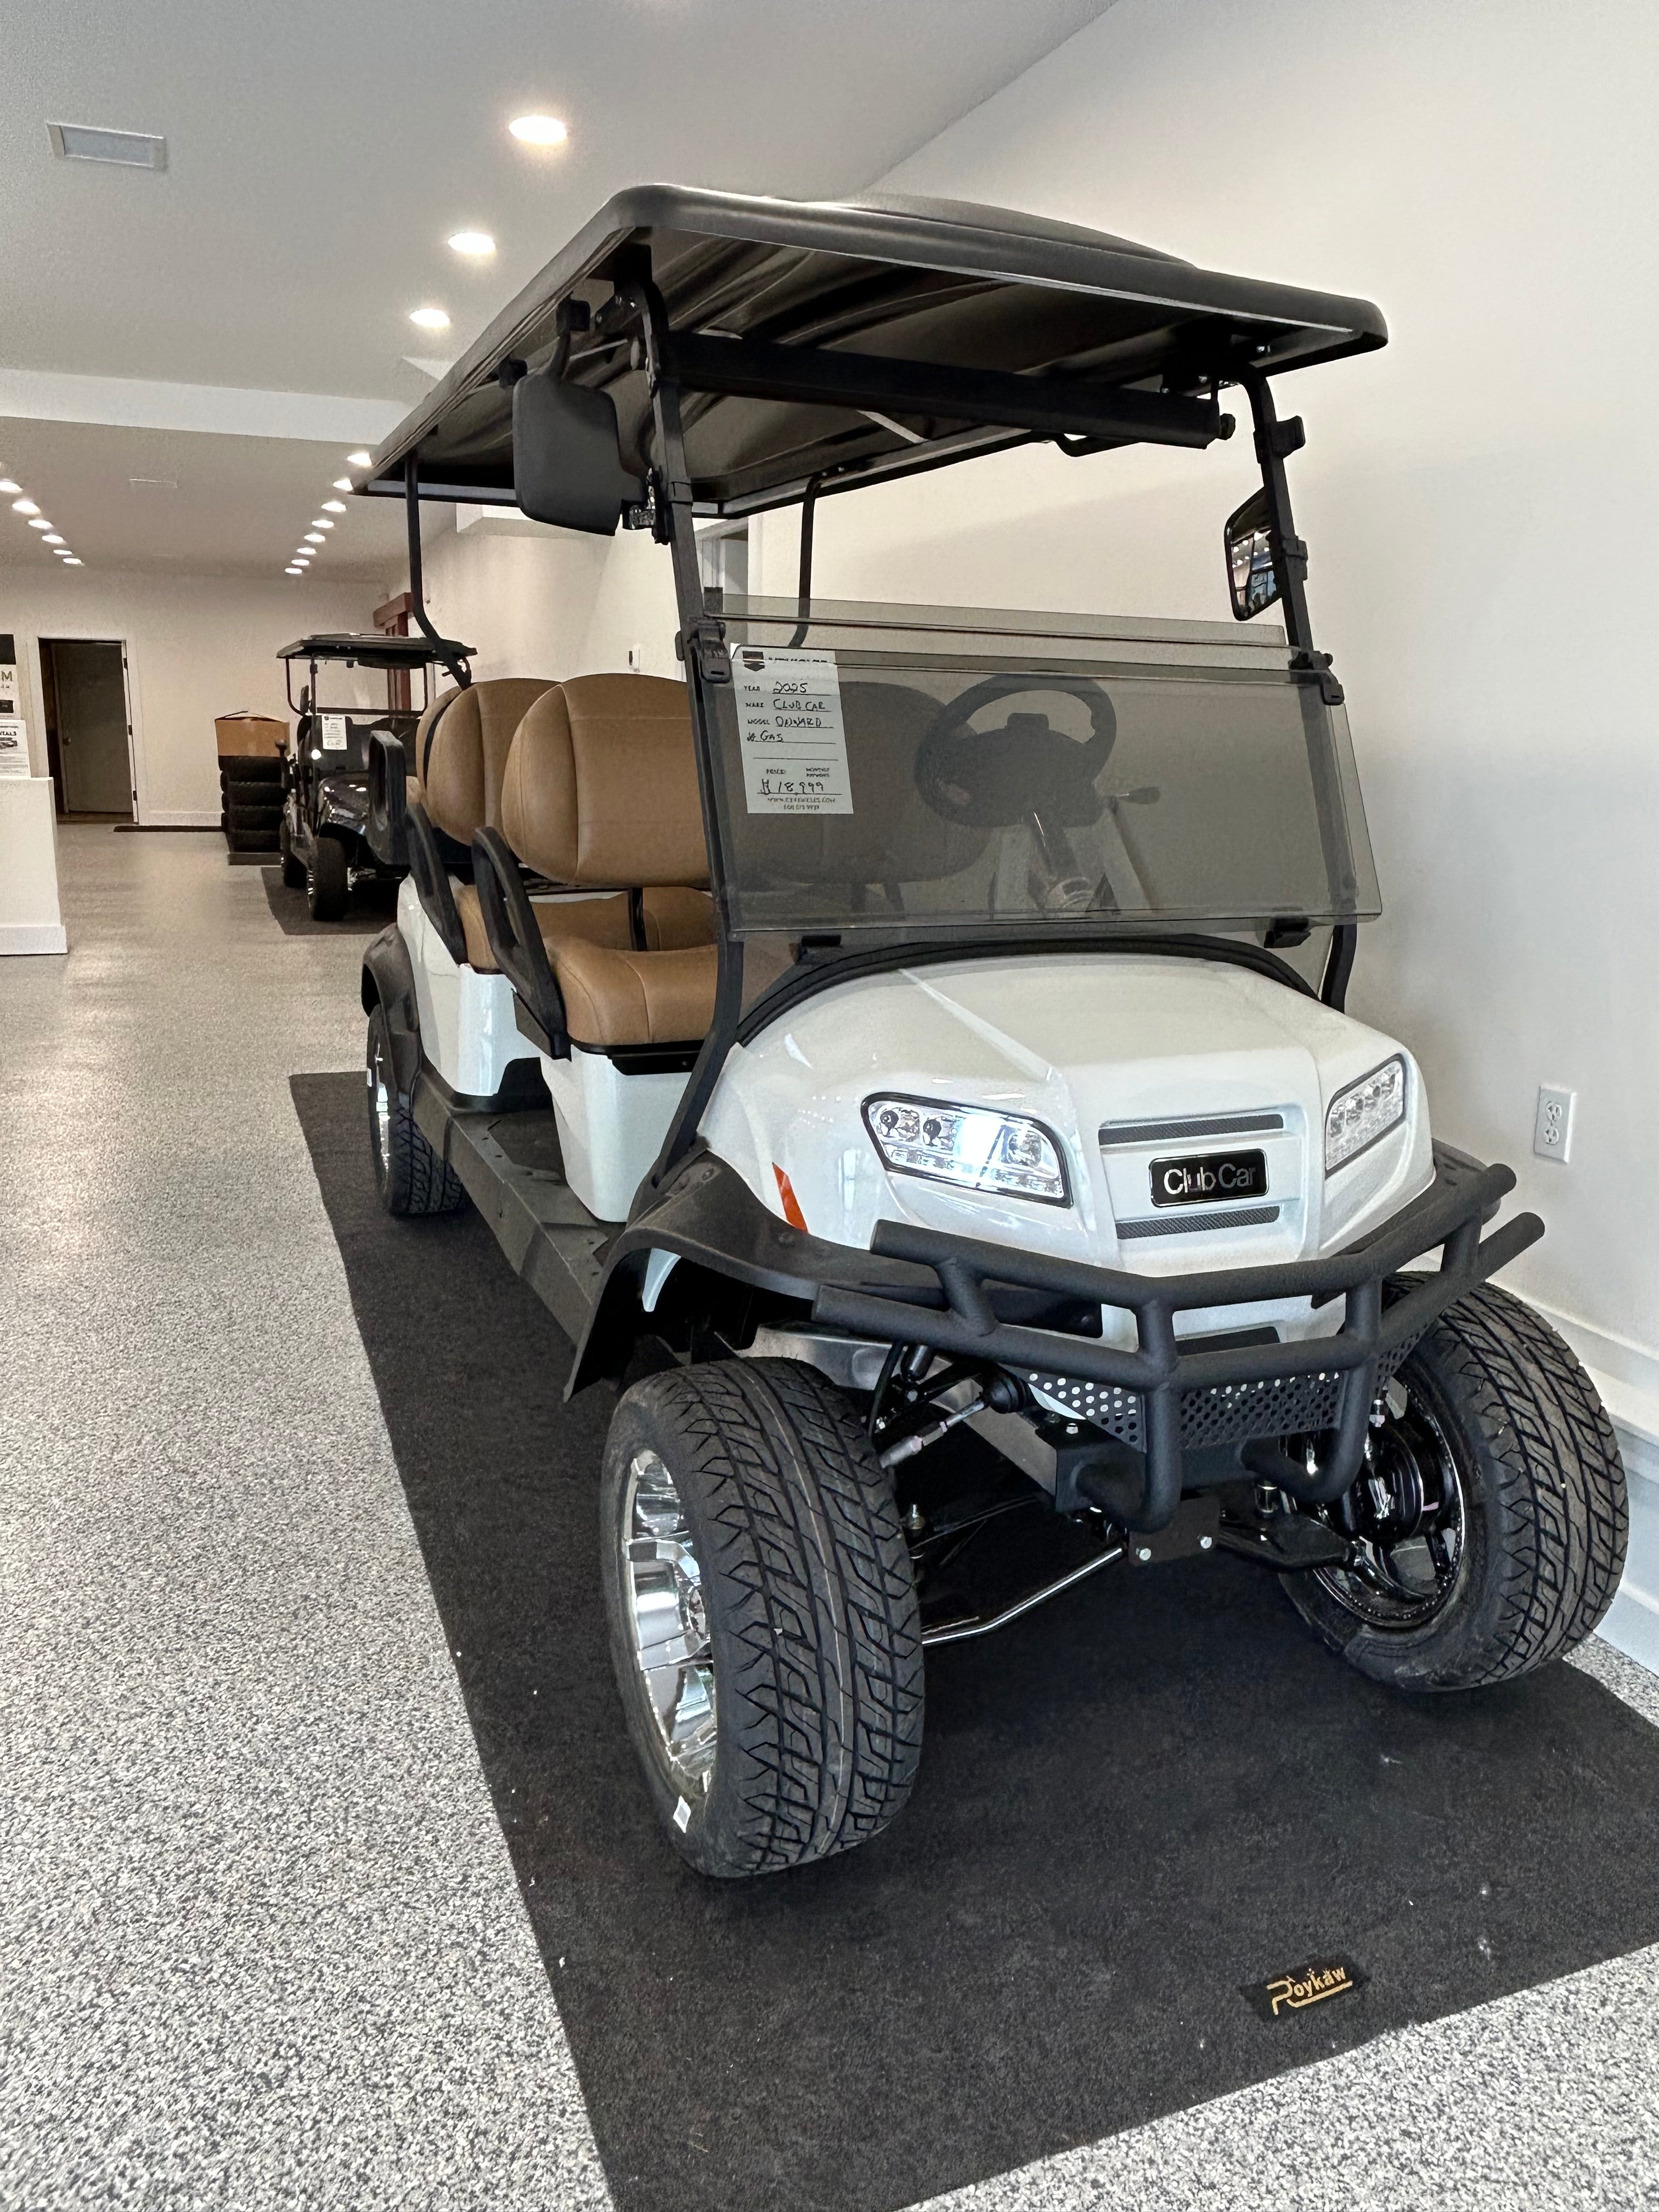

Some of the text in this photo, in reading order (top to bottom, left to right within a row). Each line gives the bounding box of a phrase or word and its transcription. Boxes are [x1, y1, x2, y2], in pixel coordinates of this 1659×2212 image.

[773, 681, 808, 693] 2025
[1164, 1163, 1256, 1195] Club Car
[1266, 1967, 1353, 2016] Roykaw
